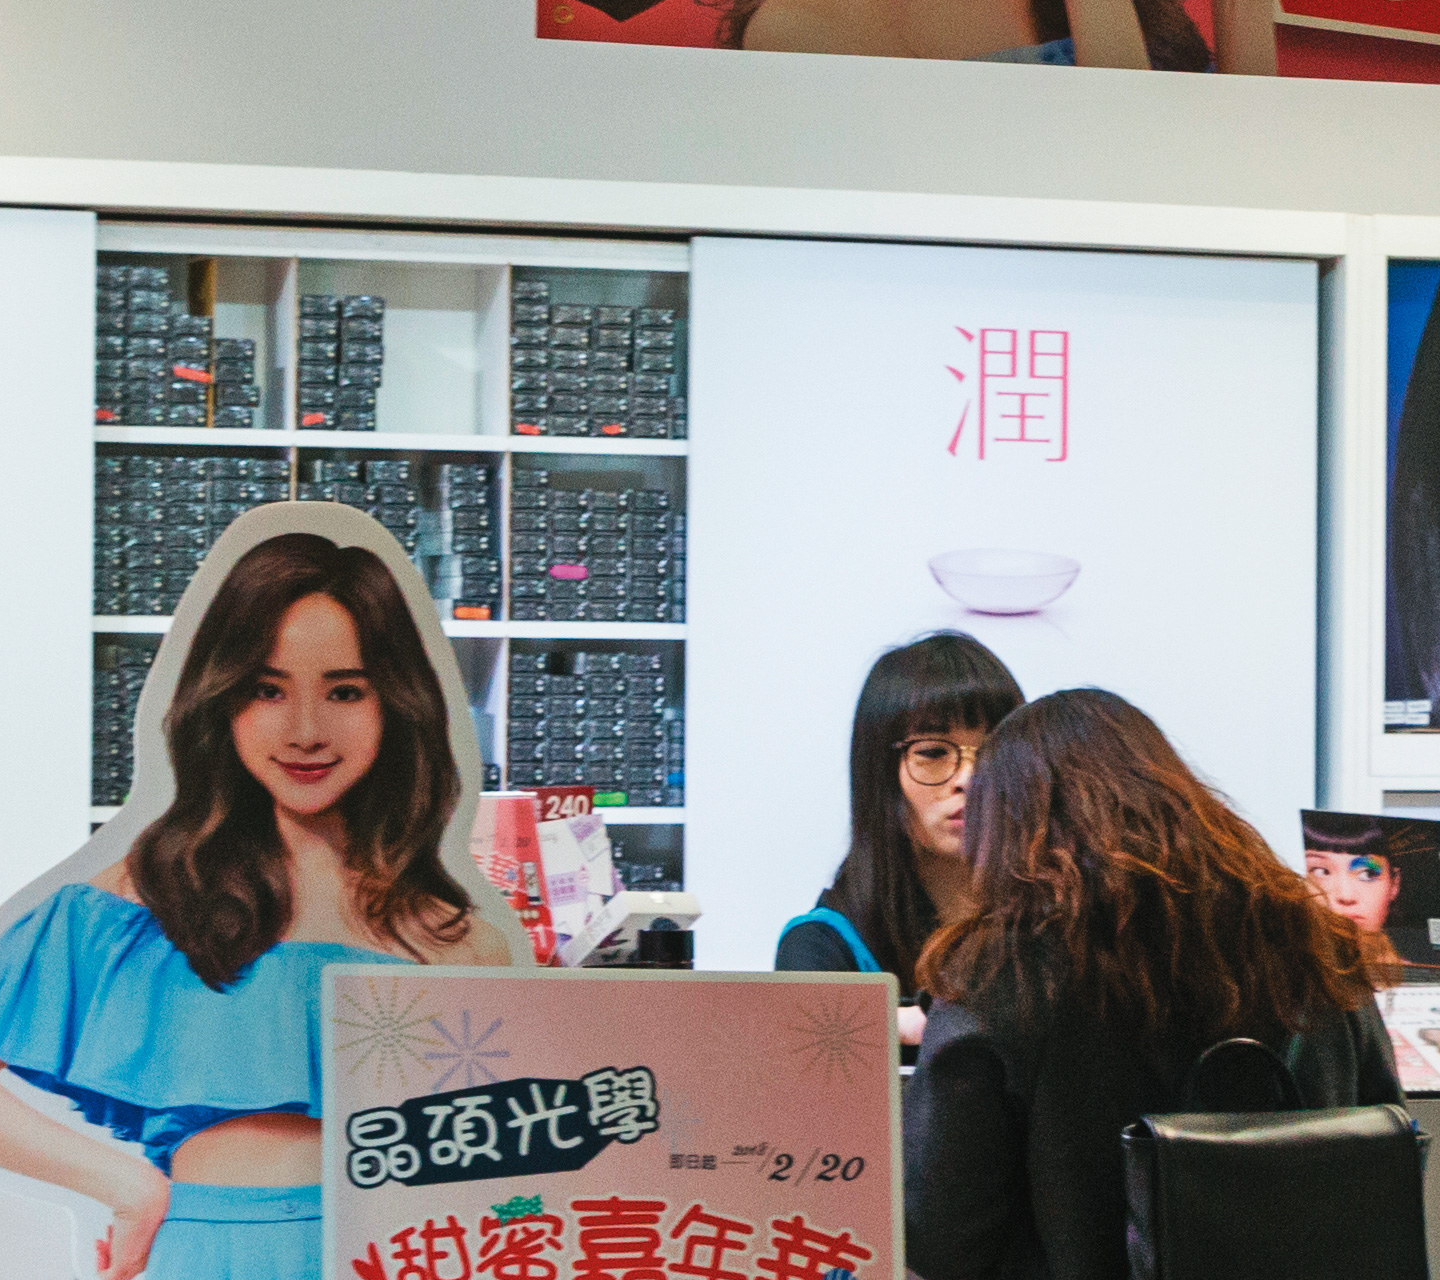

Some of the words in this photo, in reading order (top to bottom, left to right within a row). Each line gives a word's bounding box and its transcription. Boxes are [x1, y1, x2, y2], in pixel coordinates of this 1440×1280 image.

[944, 325, 1070, 462] 潤
[545, 794, 590, 820] 240
[349, 1066, 659, 1188] 晶碩光學
